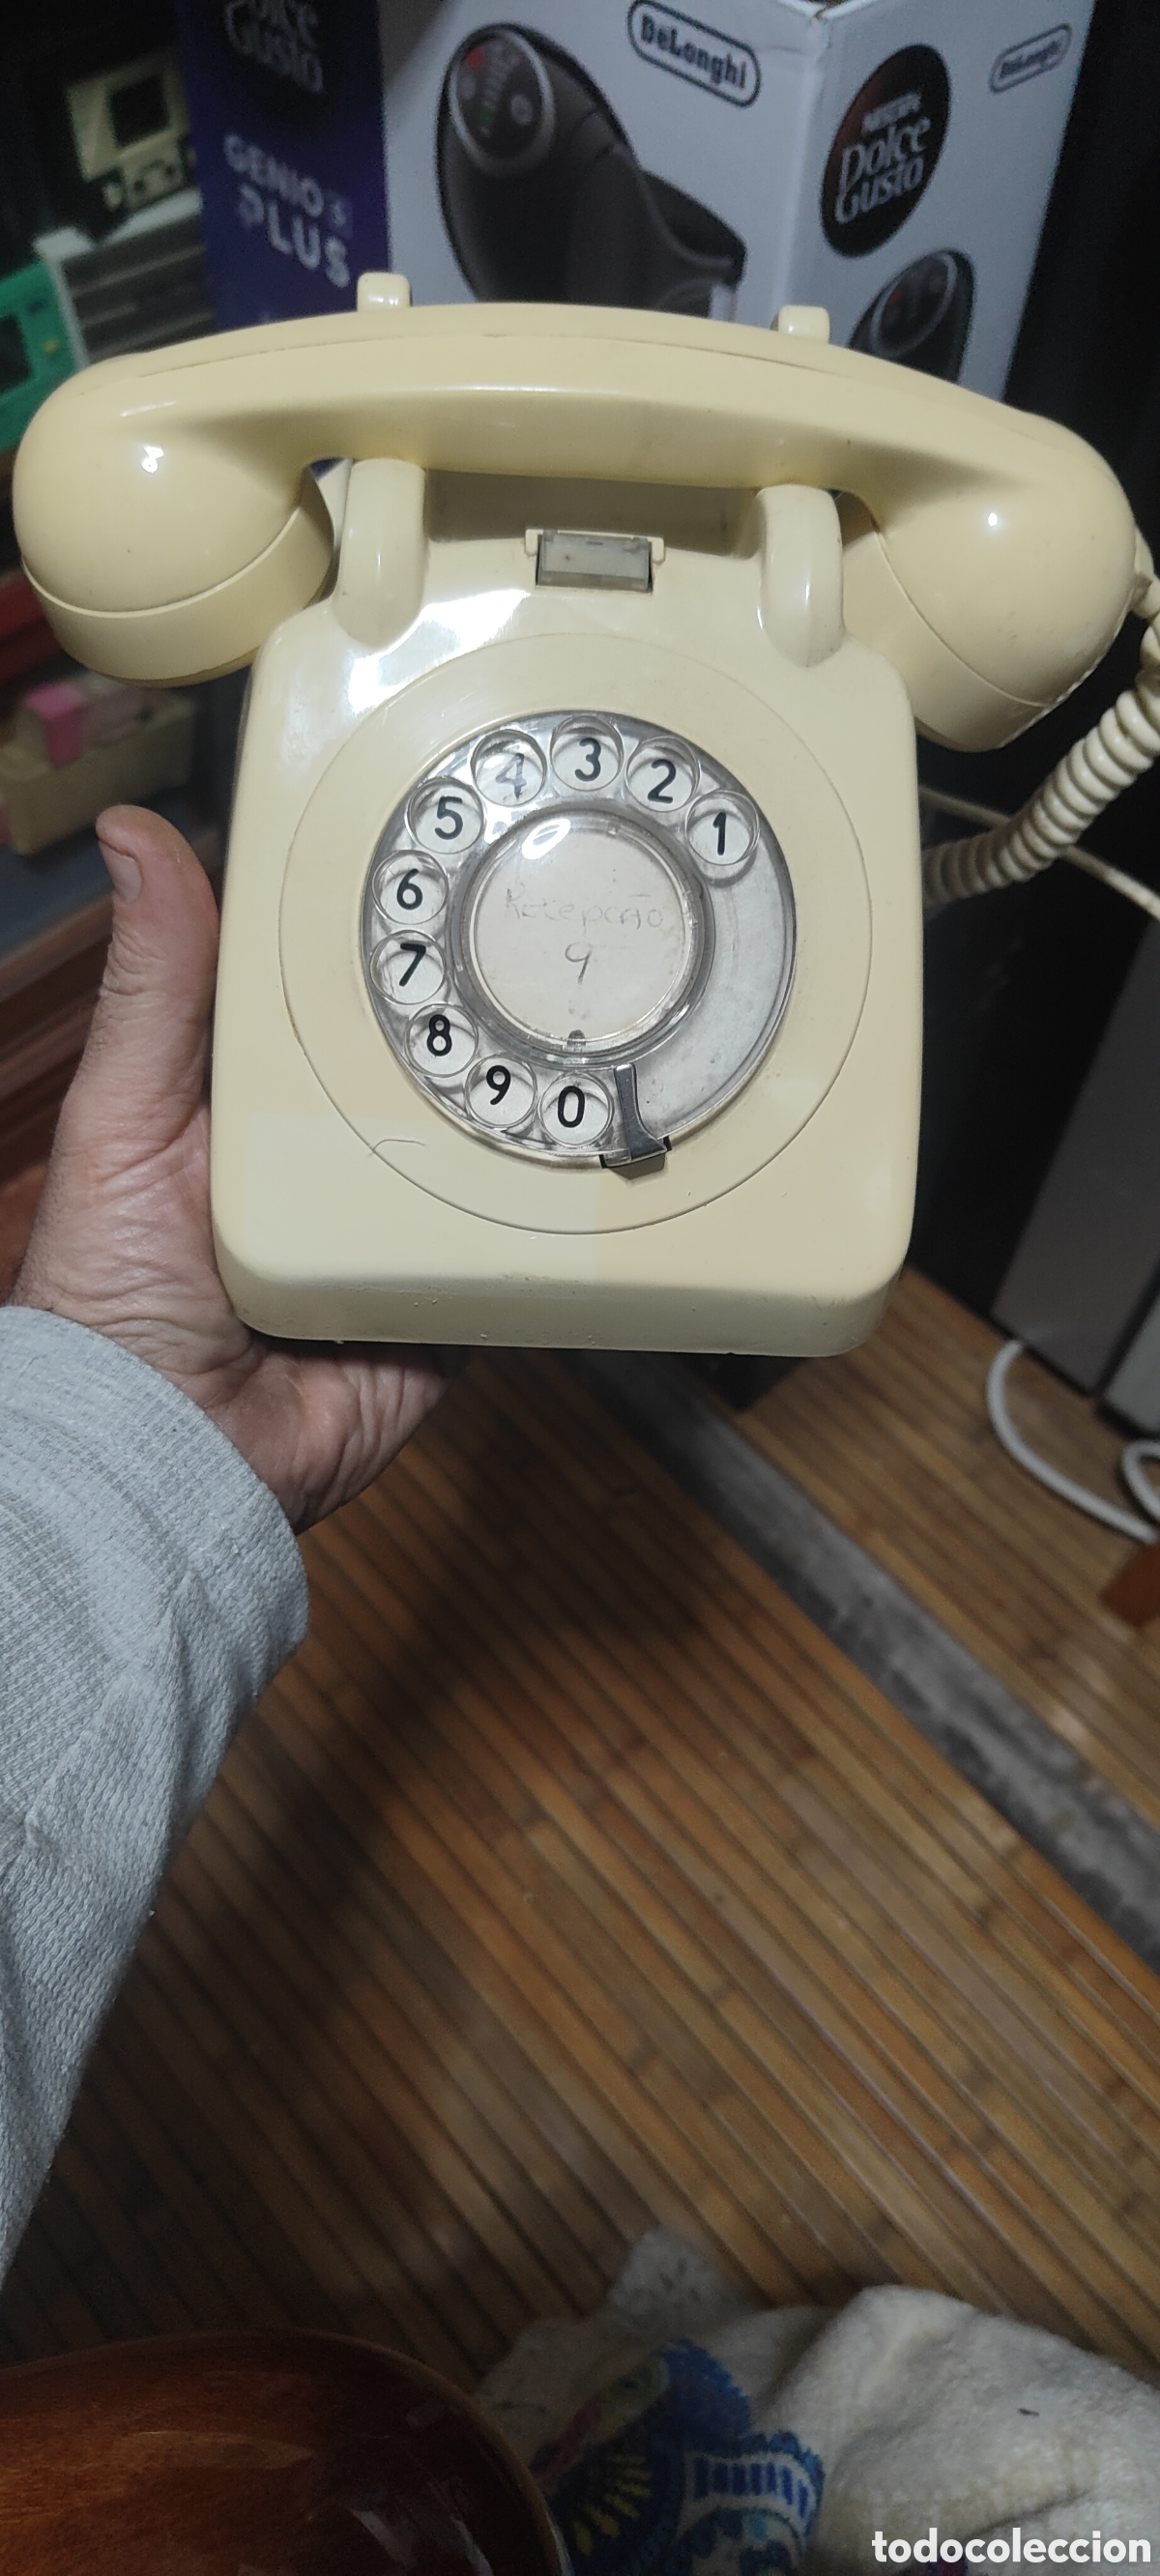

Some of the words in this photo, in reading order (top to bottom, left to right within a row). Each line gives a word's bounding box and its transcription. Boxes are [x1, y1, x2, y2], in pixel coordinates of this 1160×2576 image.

[640, 14, 746, 89] DeLonghi
[239, 184, 351, 288] PLUS
[495, 752, 526, 799] 4
[574, 738, 602, 782] 3
[647, 759, 676, 803] 2
[433, 796, 464, 840] 5
[711, 812, 727, 855] 1
[395, 868, 423, 911] 6
[398, 942, 426, 987] 7
[426, 1014, 453, 1056] 8
[486, 1065, 511, 1106] 9
[557, 1085, 585, 1128] 0
